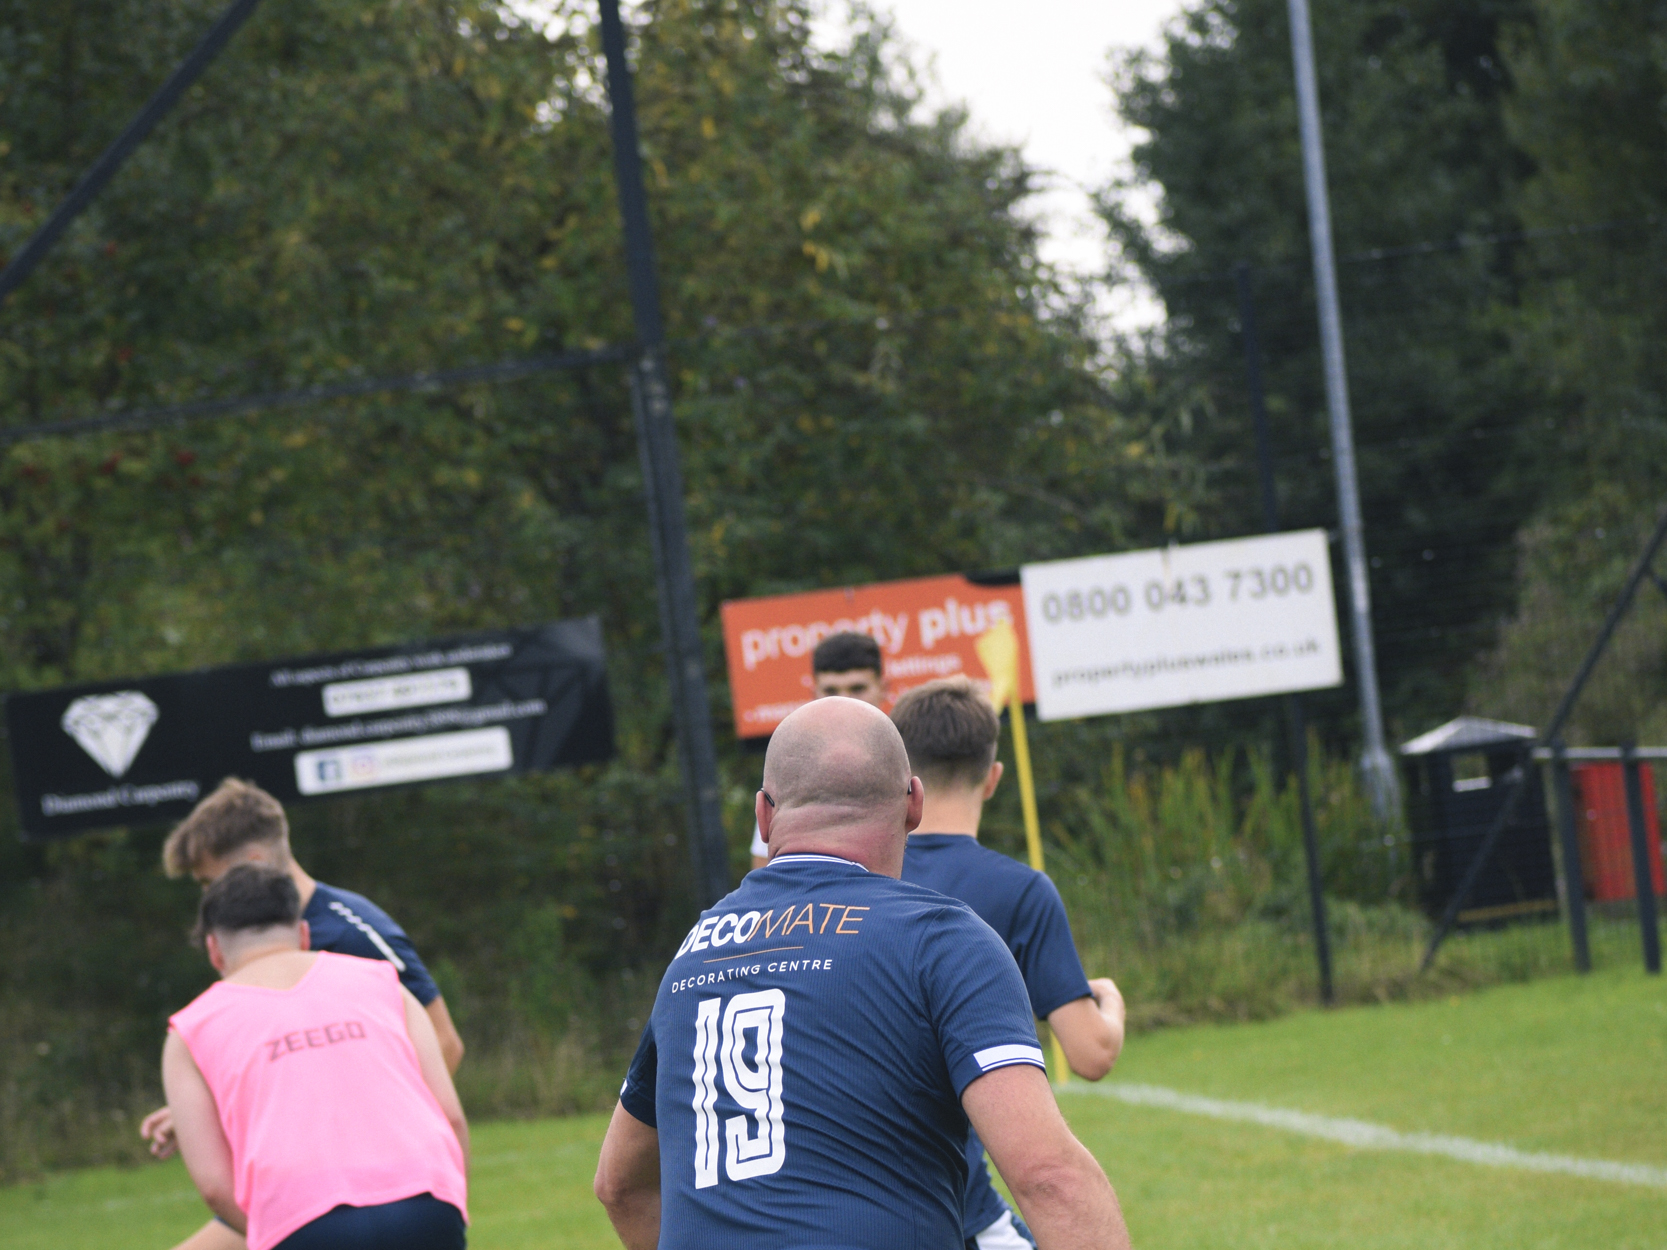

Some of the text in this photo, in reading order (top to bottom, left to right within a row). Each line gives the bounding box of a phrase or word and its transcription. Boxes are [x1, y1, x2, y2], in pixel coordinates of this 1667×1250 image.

[1042, 583, 1132, 624] 0800
[1224, 563, 1314, 601] 7300
[671, 959, 833, 993] DECORATING CENTRE
[692, 988, 787, 1189] 19
